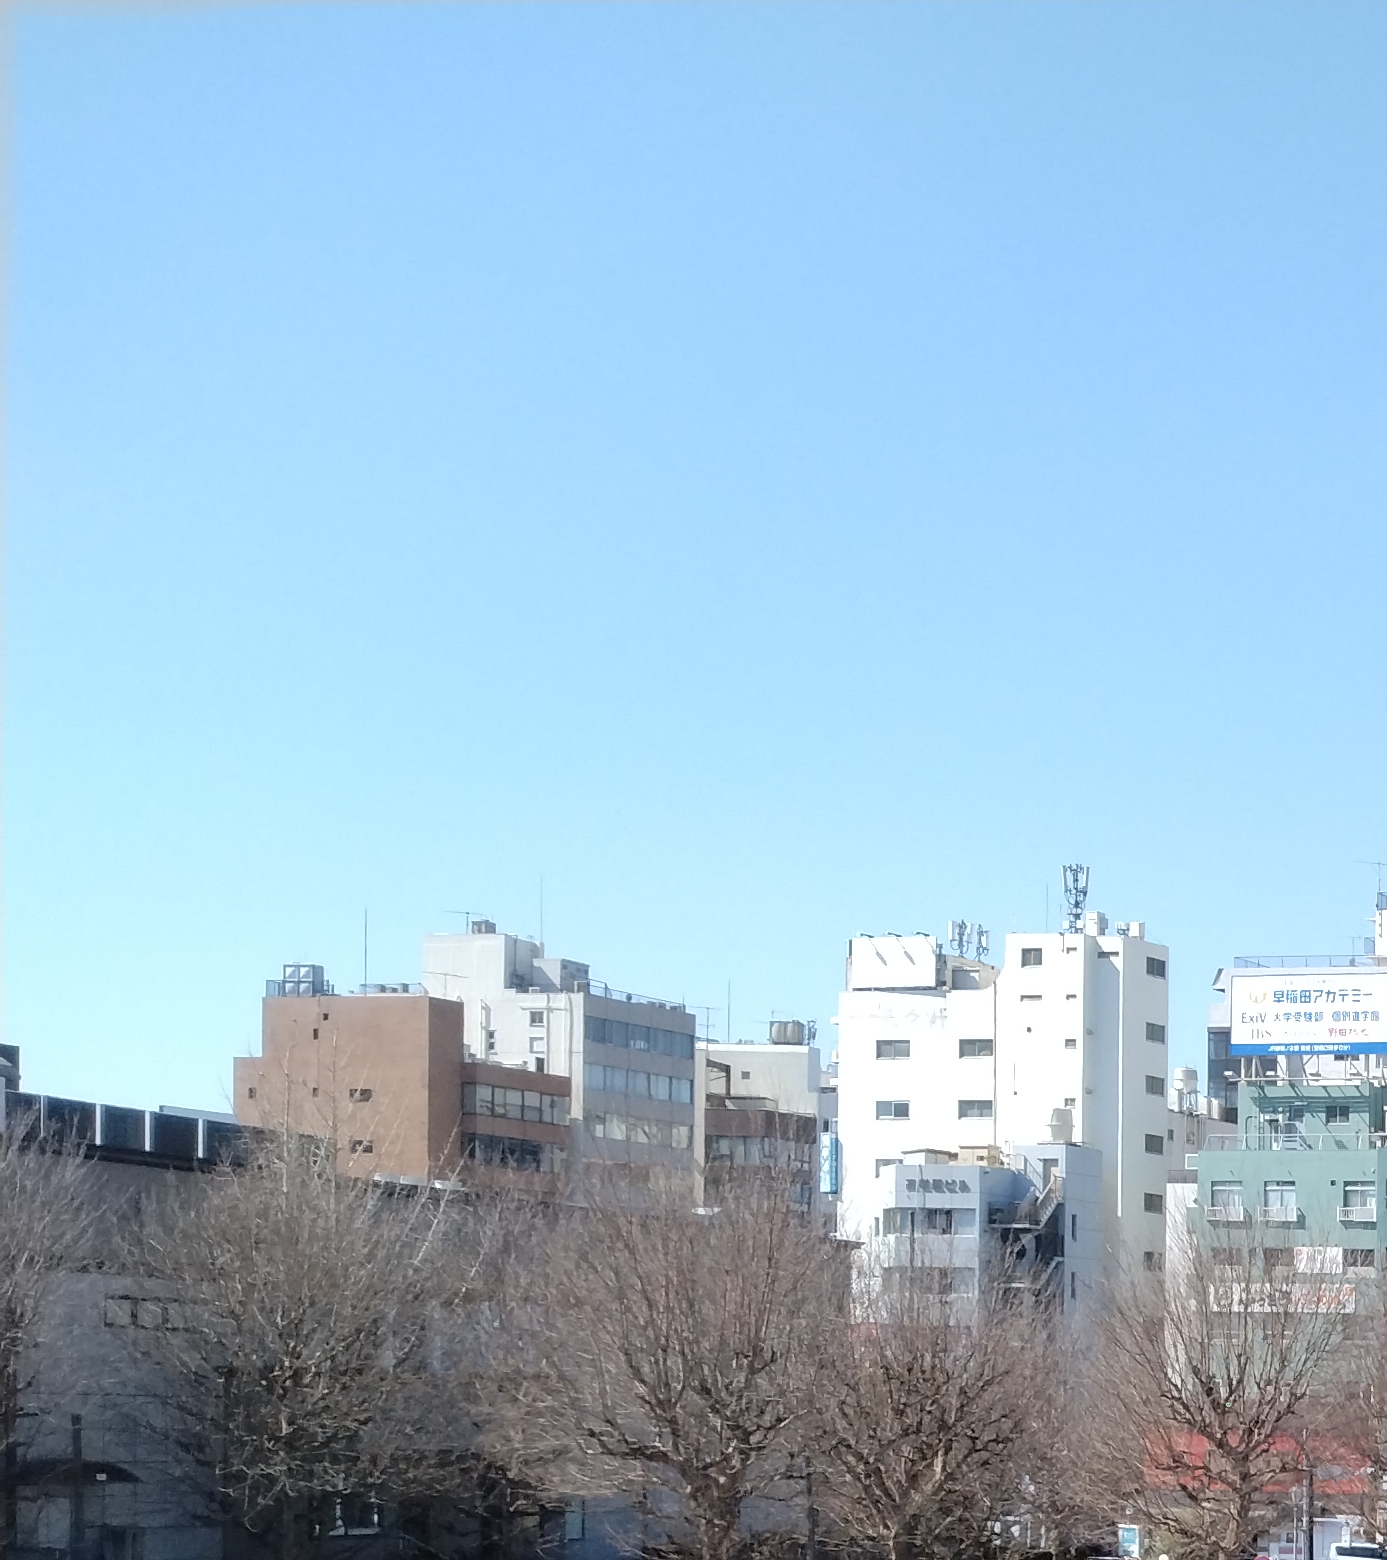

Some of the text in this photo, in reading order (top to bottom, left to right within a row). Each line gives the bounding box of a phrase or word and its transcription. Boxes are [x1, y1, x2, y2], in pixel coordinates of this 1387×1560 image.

[1273, 989, 1373, 1004] 早稲田アカデミー
